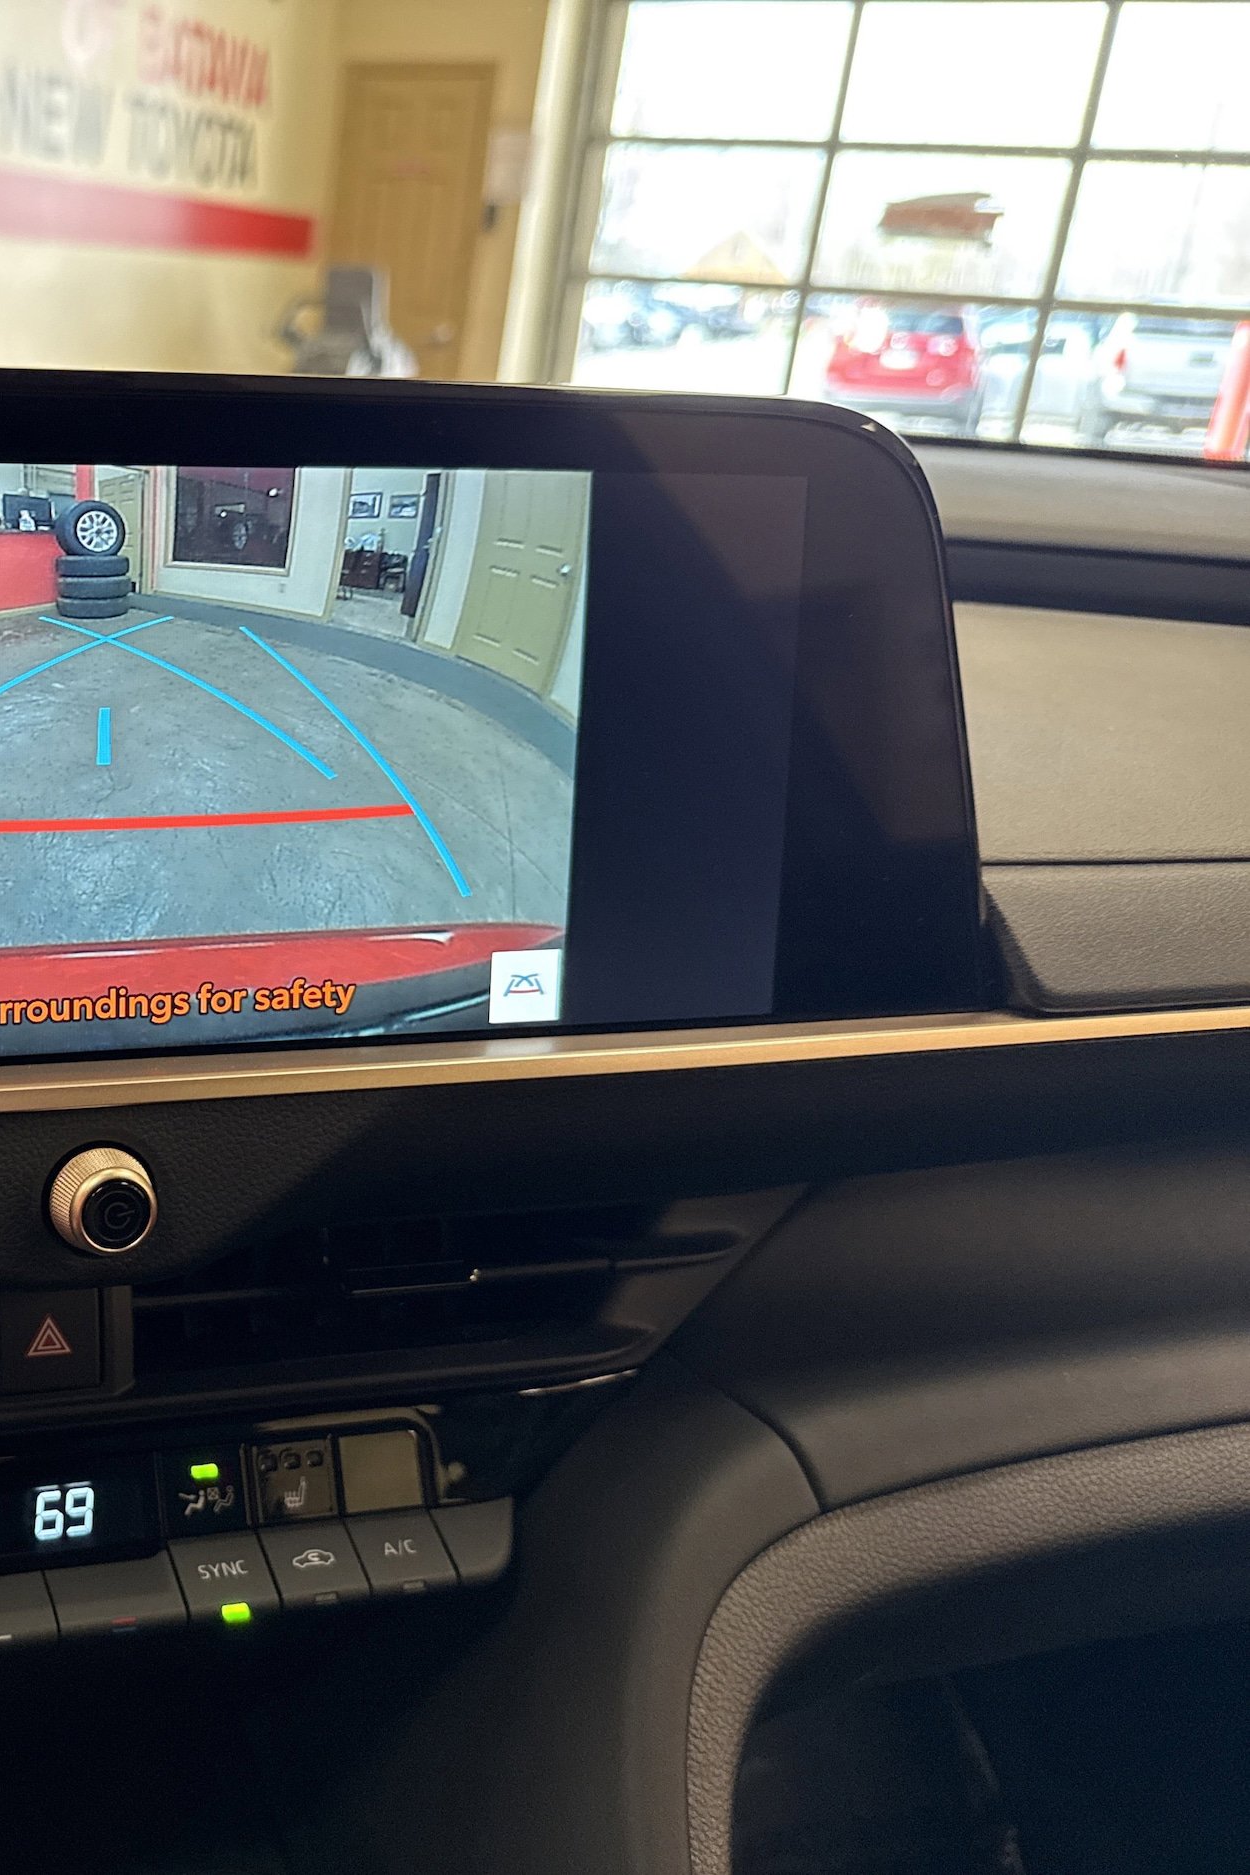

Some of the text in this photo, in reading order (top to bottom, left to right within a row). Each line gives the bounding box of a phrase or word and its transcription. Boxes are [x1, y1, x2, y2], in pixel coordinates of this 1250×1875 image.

[197, 982, 251, 1016] for
[253, 978, 357, 1016] safety
[34, 1486, 95, 1541] 69
[383, 1538, 418, 1557] A/C
[197, 1560, 249, 1580] SYNC
